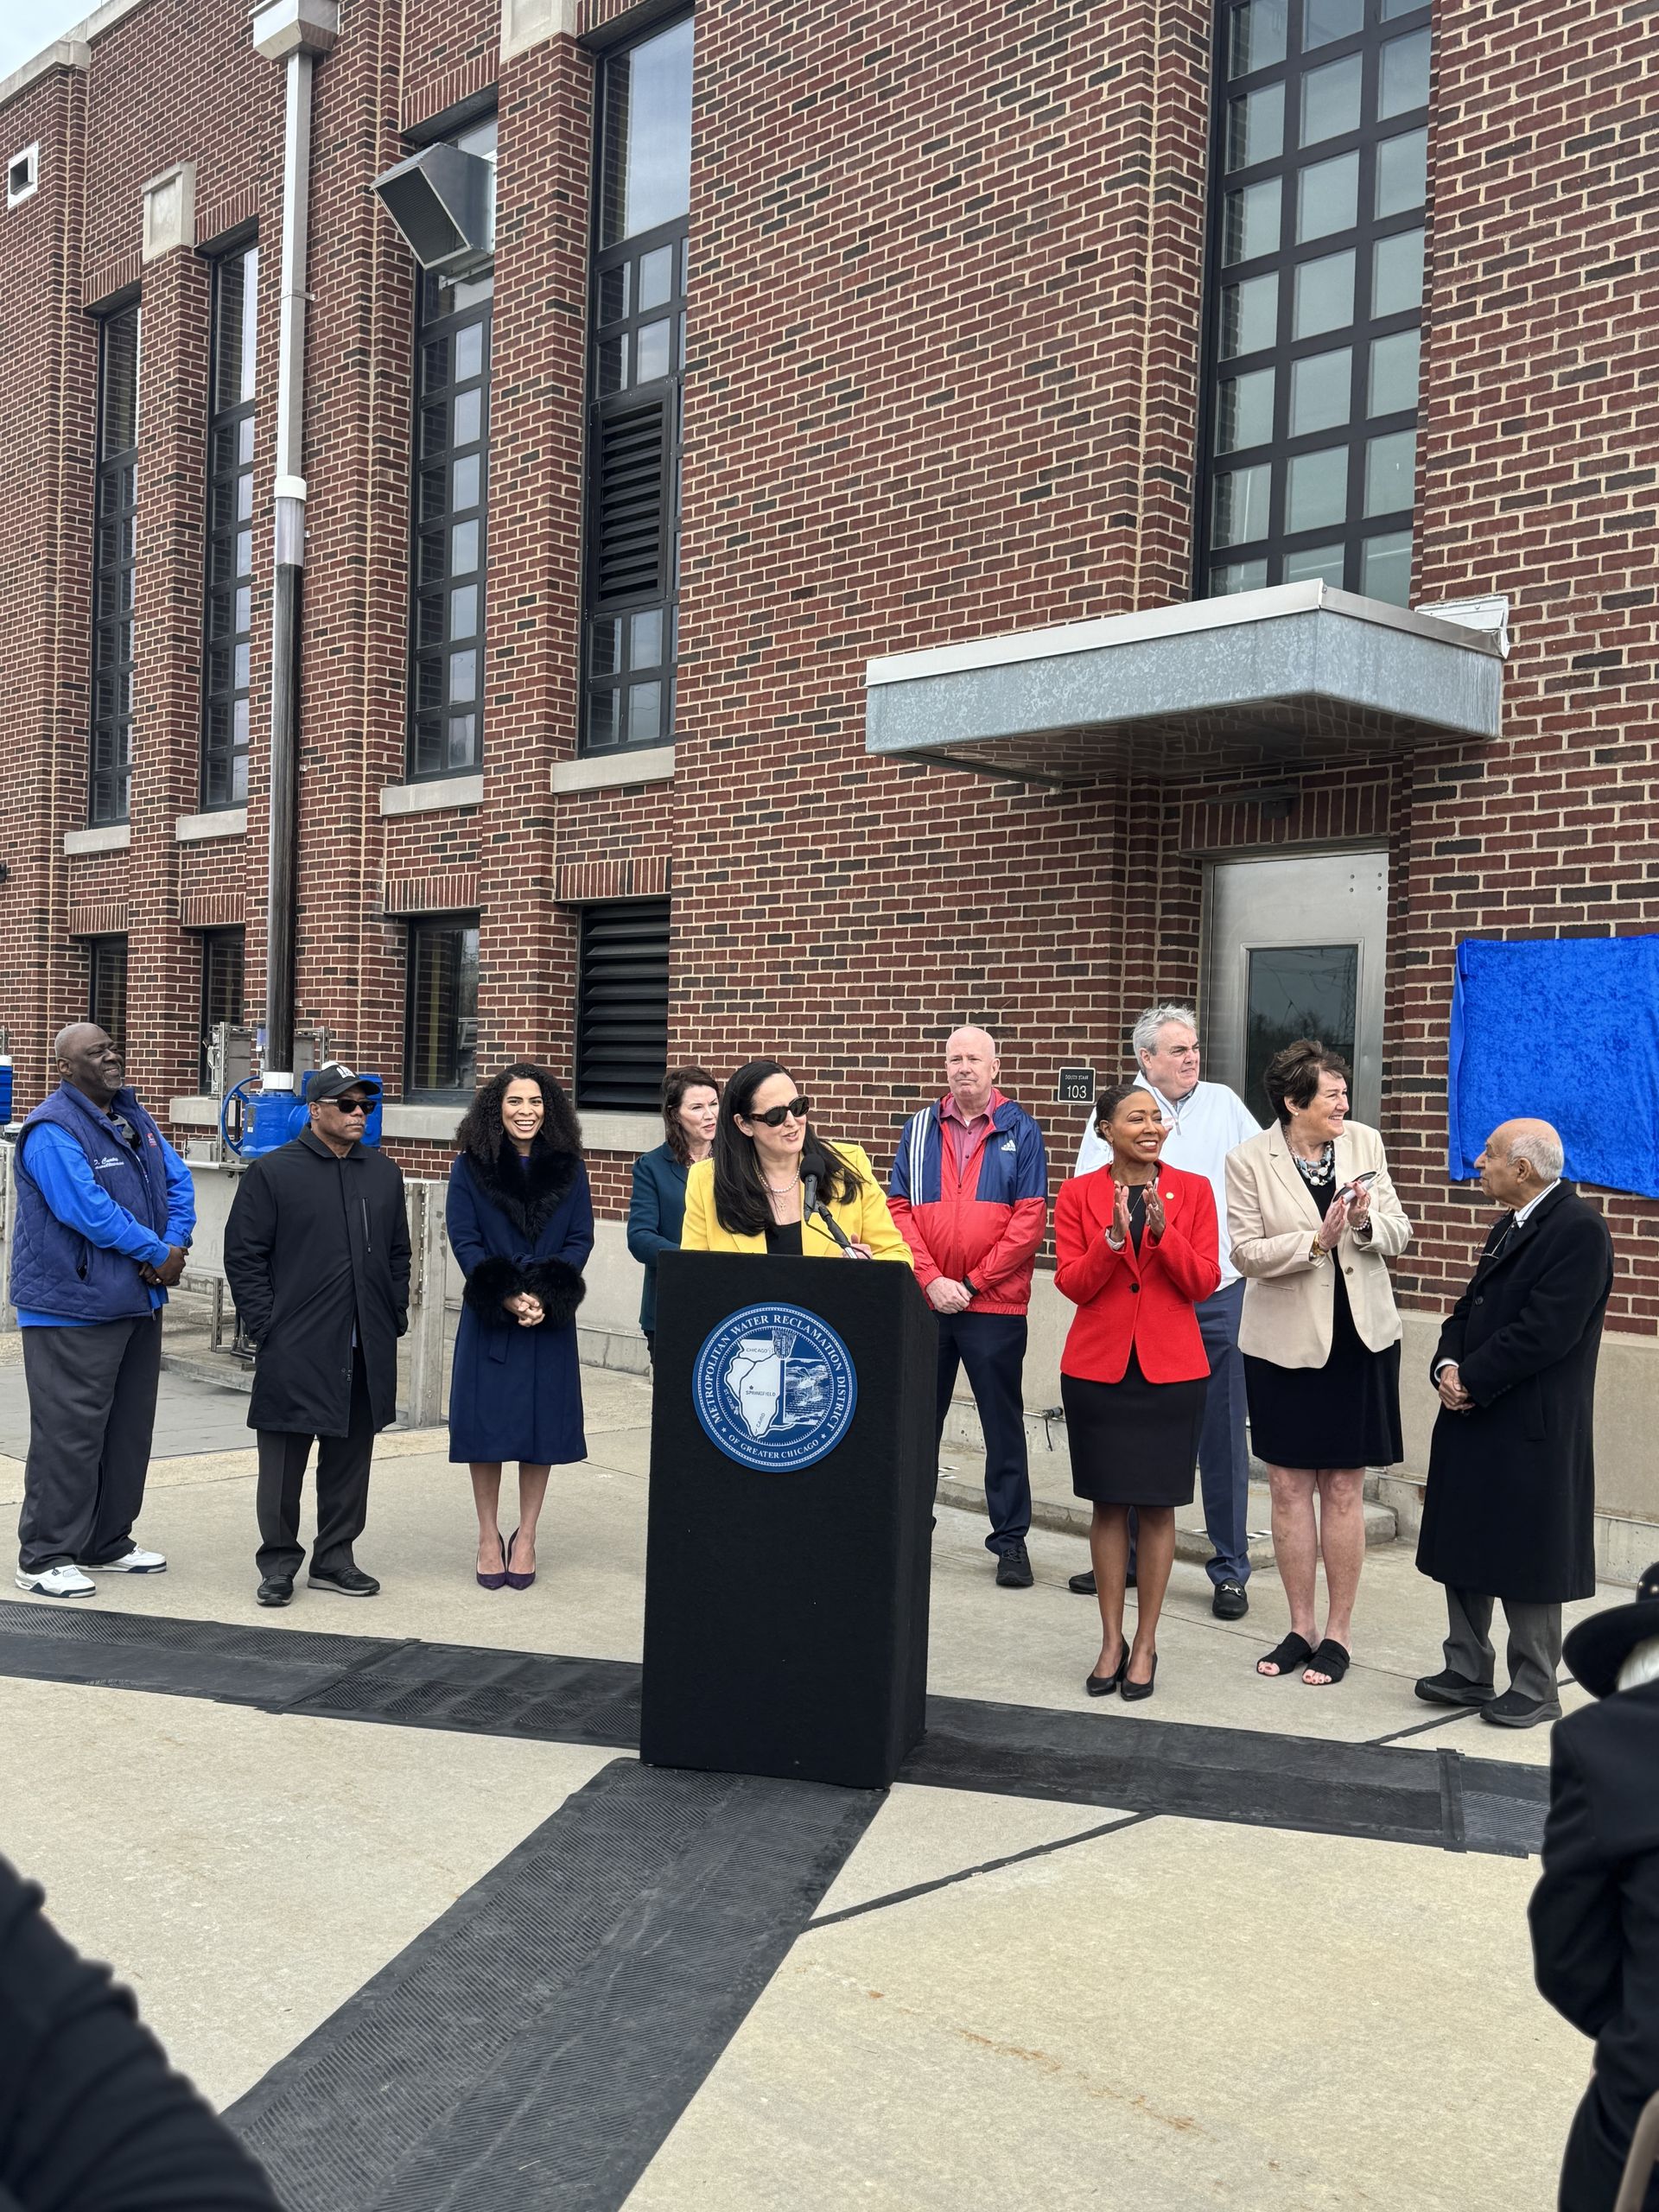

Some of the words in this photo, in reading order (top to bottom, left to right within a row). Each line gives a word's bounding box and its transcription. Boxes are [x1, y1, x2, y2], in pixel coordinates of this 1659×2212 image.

[1066, 1085, 1086, 1098] 103
[704, 1334, 731, 1425] METROPOLITAN
[730, 1314, 769, 1336] WATER
[773, 1314, 843, 1371] RECLAMATION
[827, 1376, 846, 1432] DISTRICT
[728, 1434, 739, 1446] OF
[741, 1443, 779, 1459] GREATER
[781, 1439, 819, 1459] CHICAGO
